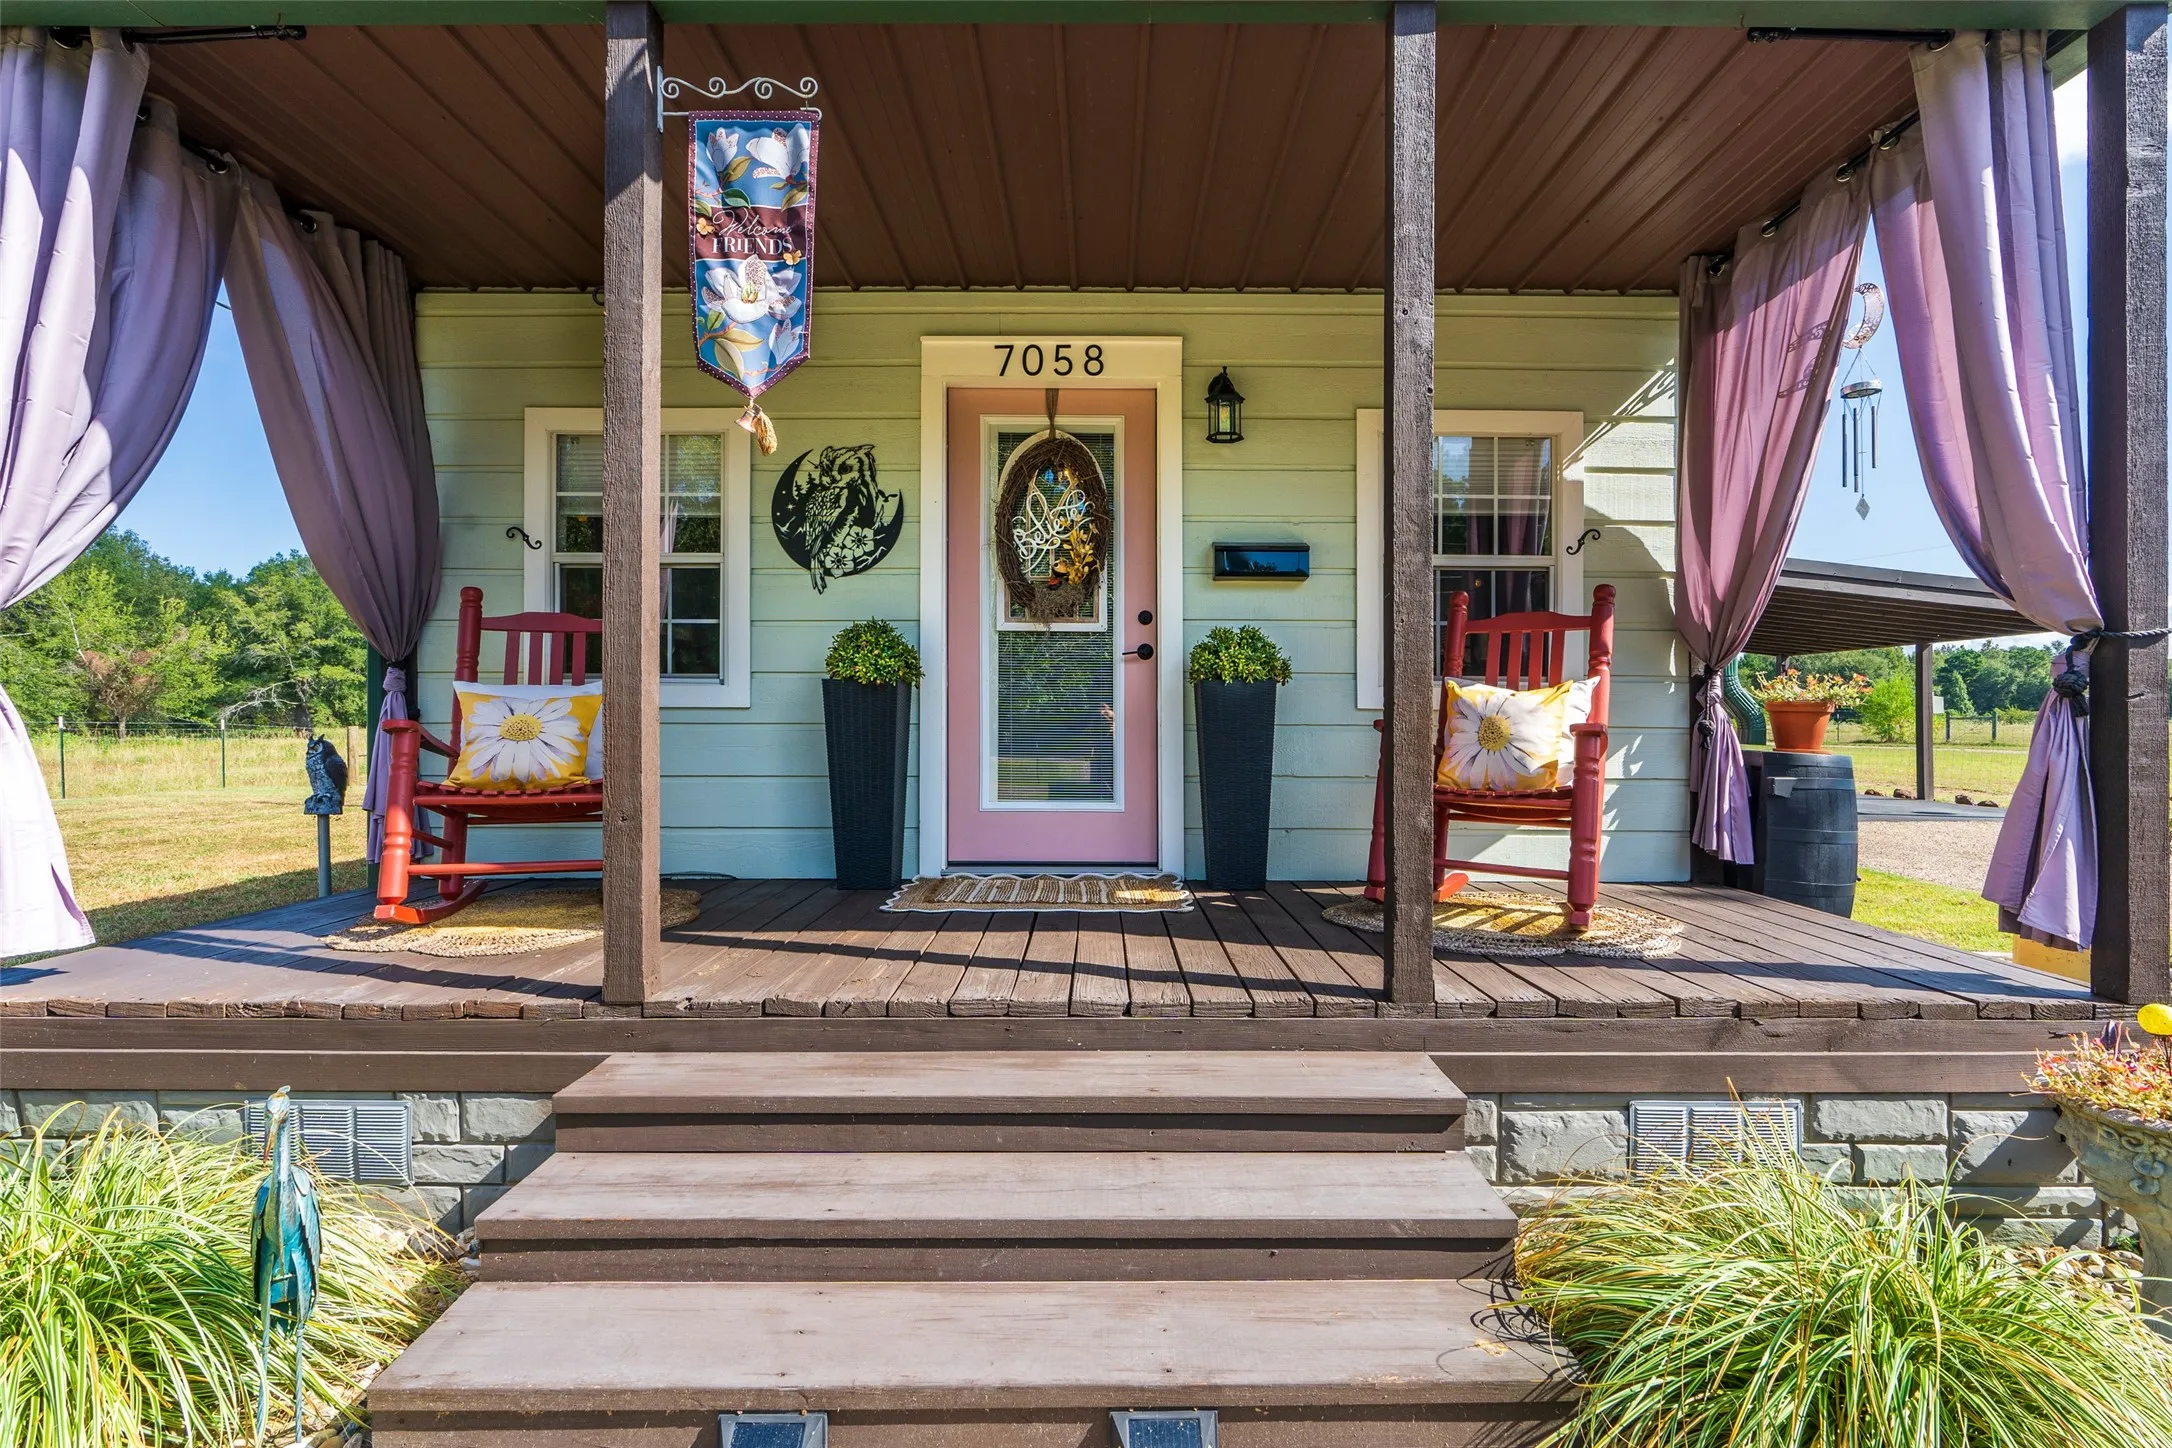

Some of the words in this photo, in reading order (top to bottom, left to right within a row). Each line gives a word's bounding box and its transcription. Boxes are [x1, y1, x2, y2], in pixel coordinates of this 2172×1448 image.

[712, 207, 792, 236] Welcome
[711, 236, 793, 255] FRIENDS
[994, 344, 1104, 376] 7058
[1012, 489, 1095, 573] Believe
